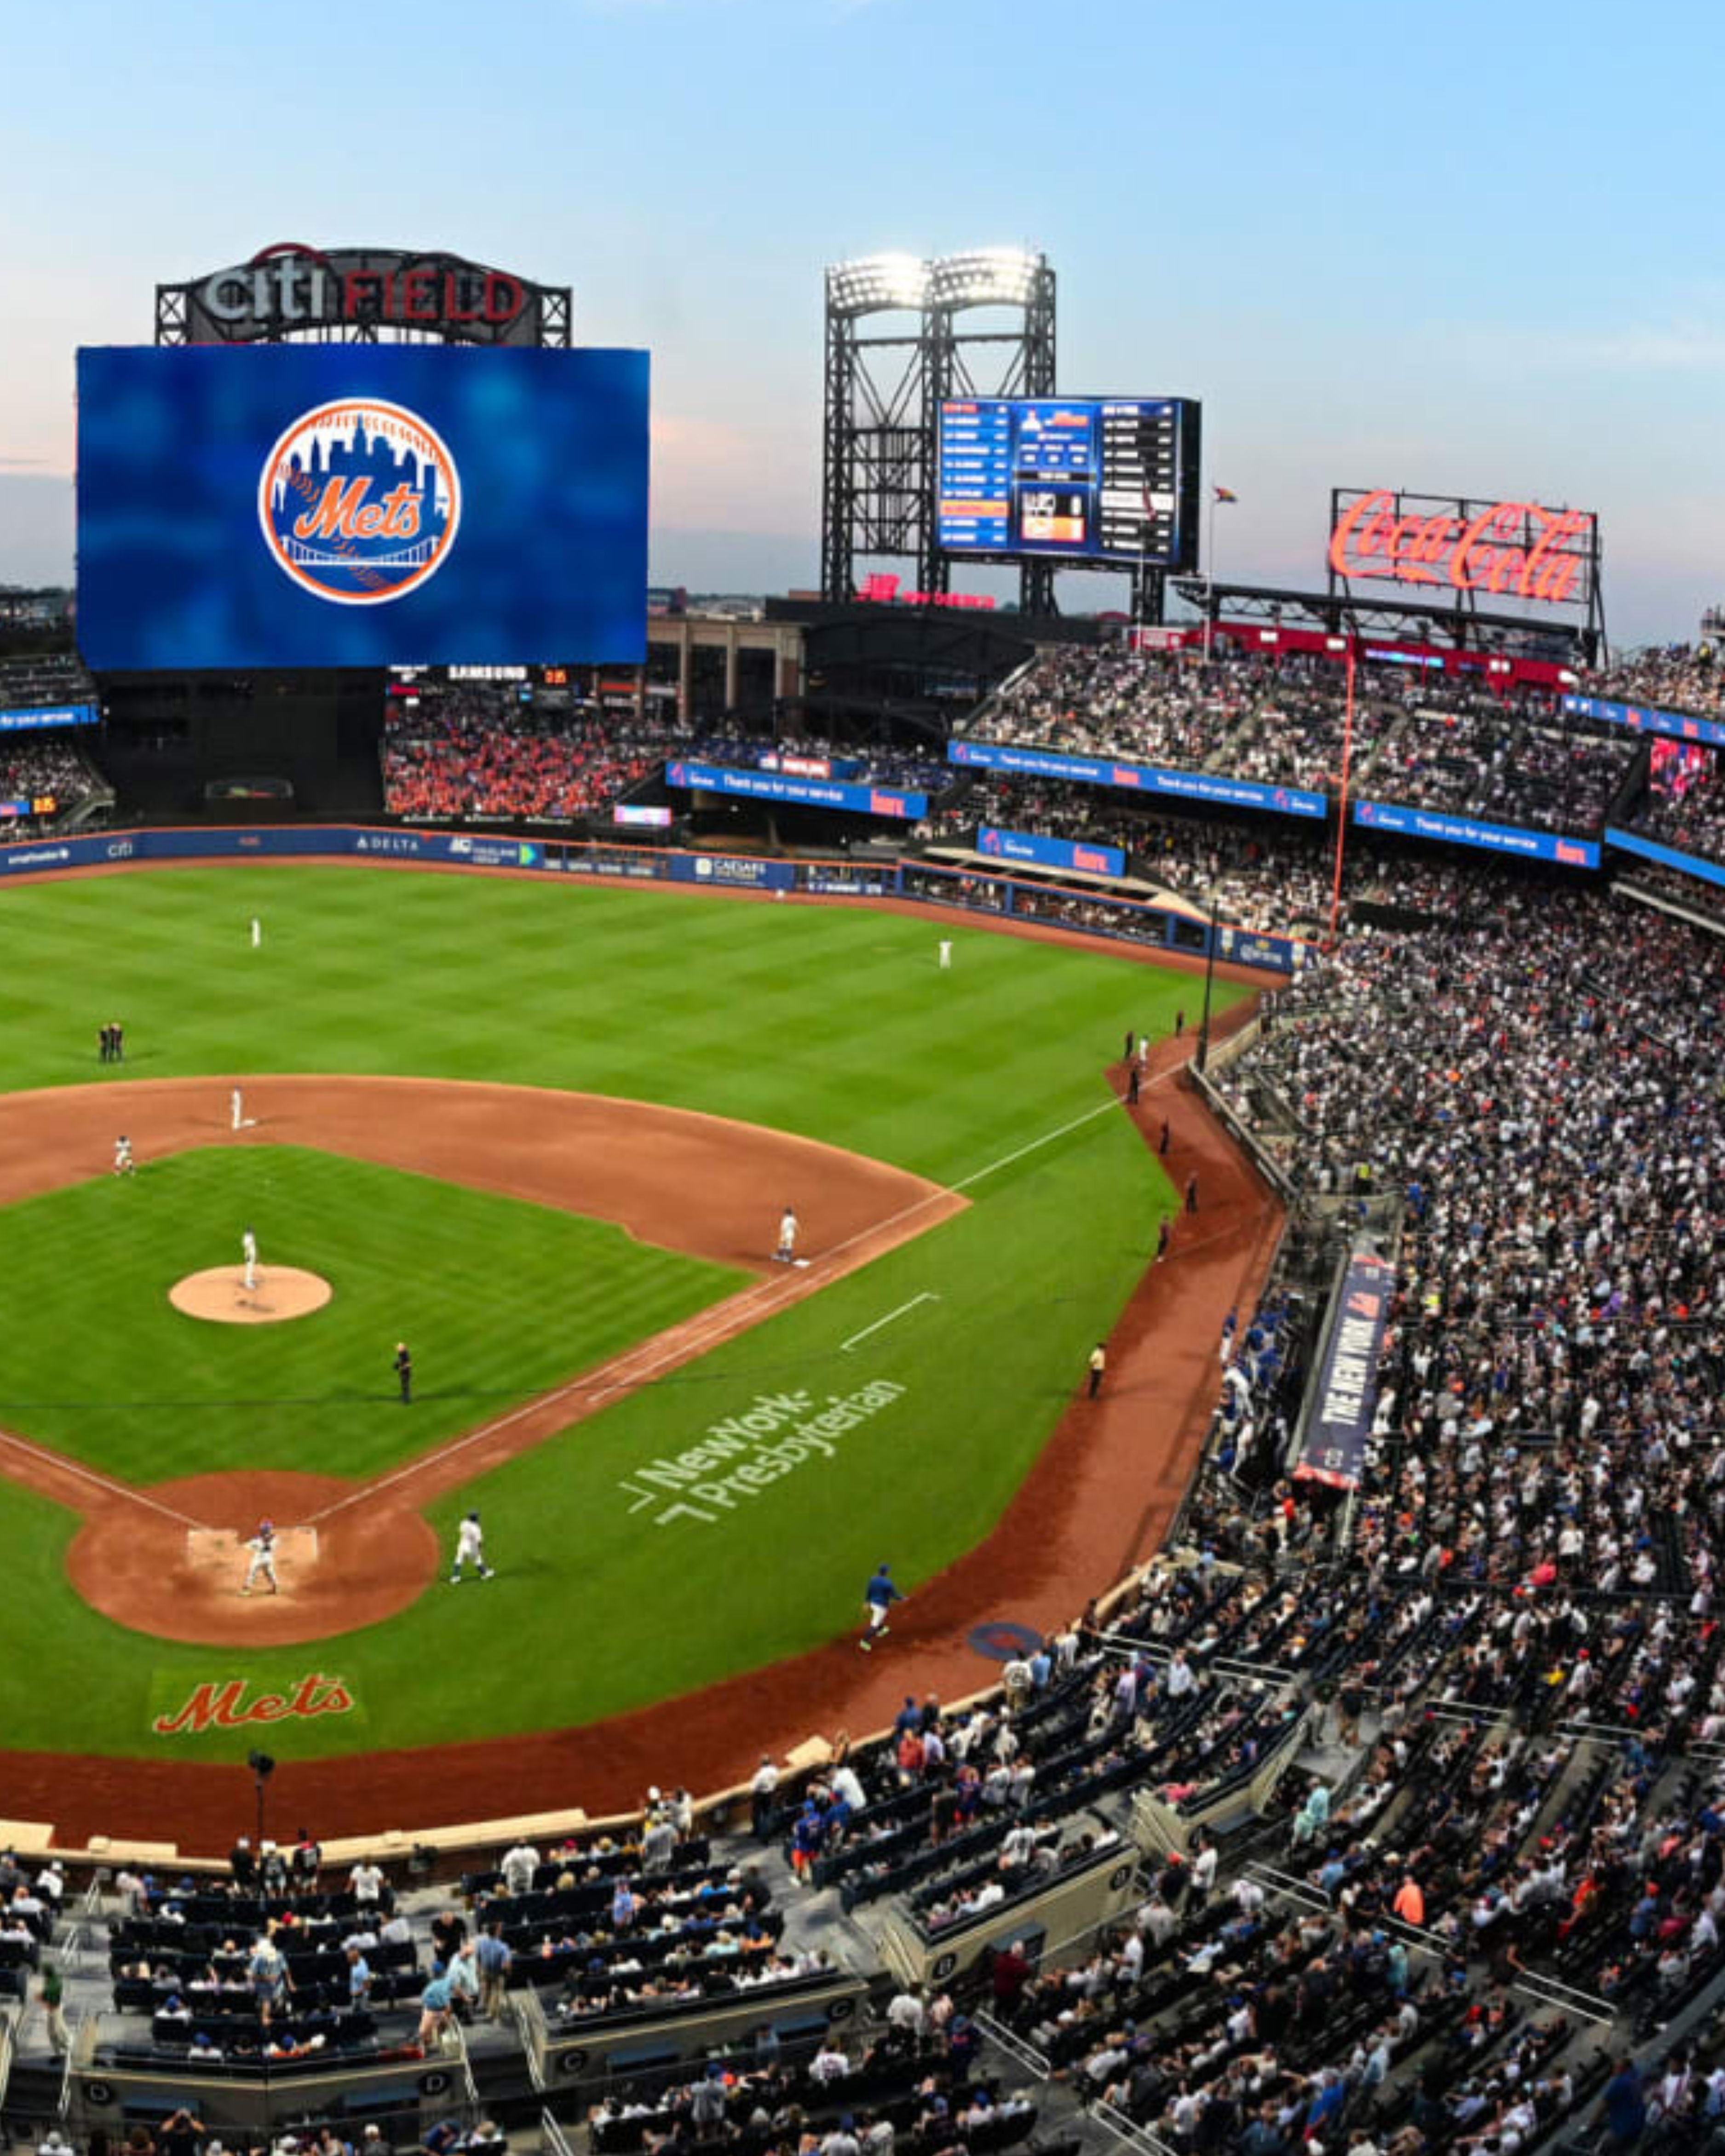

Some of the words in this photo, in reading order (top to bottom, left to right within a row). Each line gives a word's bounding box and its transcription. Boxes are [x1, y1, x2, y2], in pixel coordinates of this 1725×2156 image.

[205, 258, 325, 320] citi
[343, 271, 524, 320] FIELD
[294, 476, 422, 538] Mets
[1329, 489, 1594, 601] Coca-Cola
[724, 774, 751, 788] Thank
[1416, 816, 1443, 831] Thank
[107, 841, 132, 857] citi
[372, 836, 419, 851] DELTA
[1338, 1317, 1376, 1354] YORK
[1331, 1355, 1368, 1394] NEW
[1322, 1392, 1362, 1425] THE
[689, 1379, 907, 1509] Presbyterian
[152, 1673, 354, 1732] Mets
